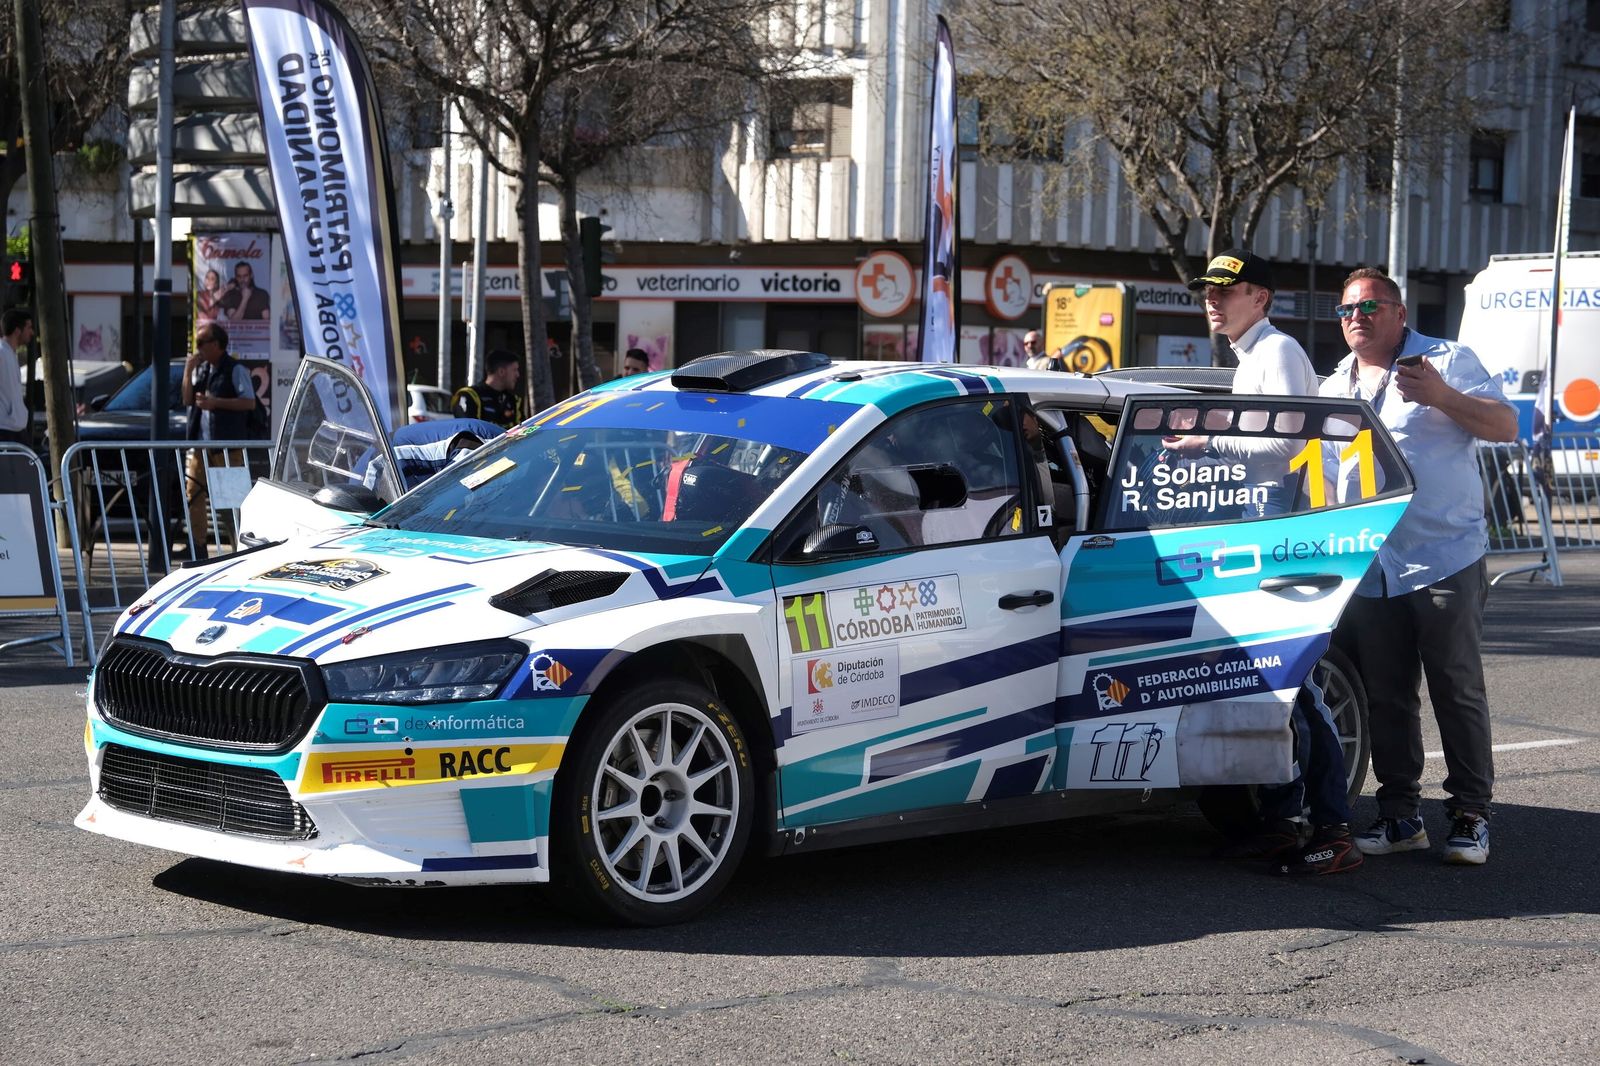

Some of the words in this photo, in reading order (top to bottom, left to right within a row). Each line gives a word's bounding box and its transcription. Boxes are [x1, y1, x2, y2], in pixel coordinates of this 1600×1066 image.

[484, 269, 520, 291] cent
[637, 272, 740, 292] veterinario
[761, 272, 841, 293] victoria
[1480, 288, 1600, 310] URGENIAS
[1121, 466, 1144, 488] J.
[1152, 463, 1247, 486] Solans
[1289, 428, 1378, 509] 11
[1121, 491, 1148, 512] R.
[1156, 485, 1268, 513] Sanjuan
[785, 594, 830, 652] 11
[915, 607, 956, 621] PATRIMONIO
[917, 616, 963, 631] HUMANIDAD
[837, 614, 914, 641] CÓRDOBA
[837, 657, 884, 673] Diputación
[837, 673, 848, 685] de
[850, 669, 884, 684] Córdoba
[1137, 662, 1211, 688] FEDERACIÓ
[1215, 655, 1282, 675] CATALANA
[861, 694, 896, 708] IMDECO
[404, 714, 525, 731] dexinformática
[321, 757, 416, 784] PIRELLI
[439, 747, 512, 779] RACC
[1304, 849, 1334, 862] sparco
